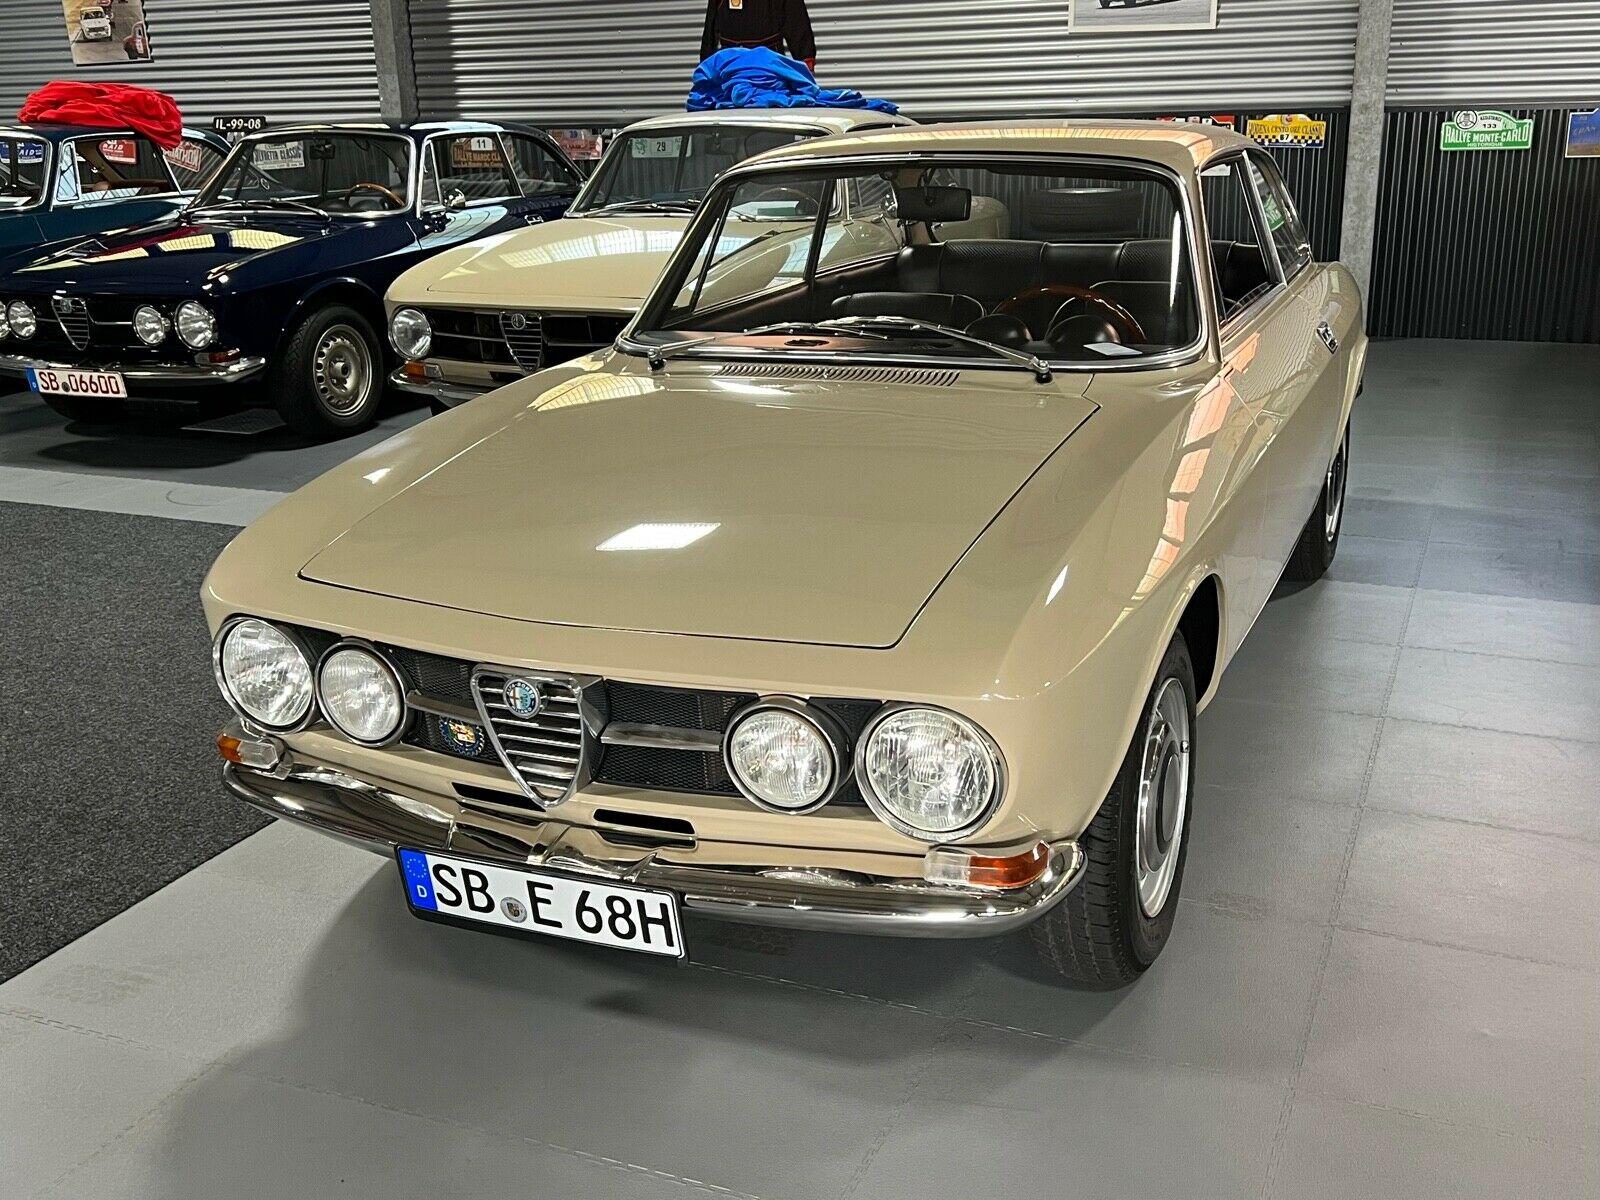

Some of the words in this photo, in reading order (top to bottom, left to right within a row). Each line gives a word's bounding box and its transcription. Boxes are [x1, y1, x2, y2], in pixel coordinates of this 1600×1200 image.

[215, 118, 261, 130] IL-99-08
[1445, 126, 1472, 144] RALLYE
[1472, 122, 1530, 144] MONTE-CARLO
[477, 139, 486, 149] 11
[656, 141, 666, 152] 29
[39, 371, 60, 391] SB
[67, 374, 120, 395] 06600
[416, 884, 429, 899] D
[431, 862, 496, 914] SB
[526, 879, 563, 929] E
[575, 889, 675, 948] 68H
